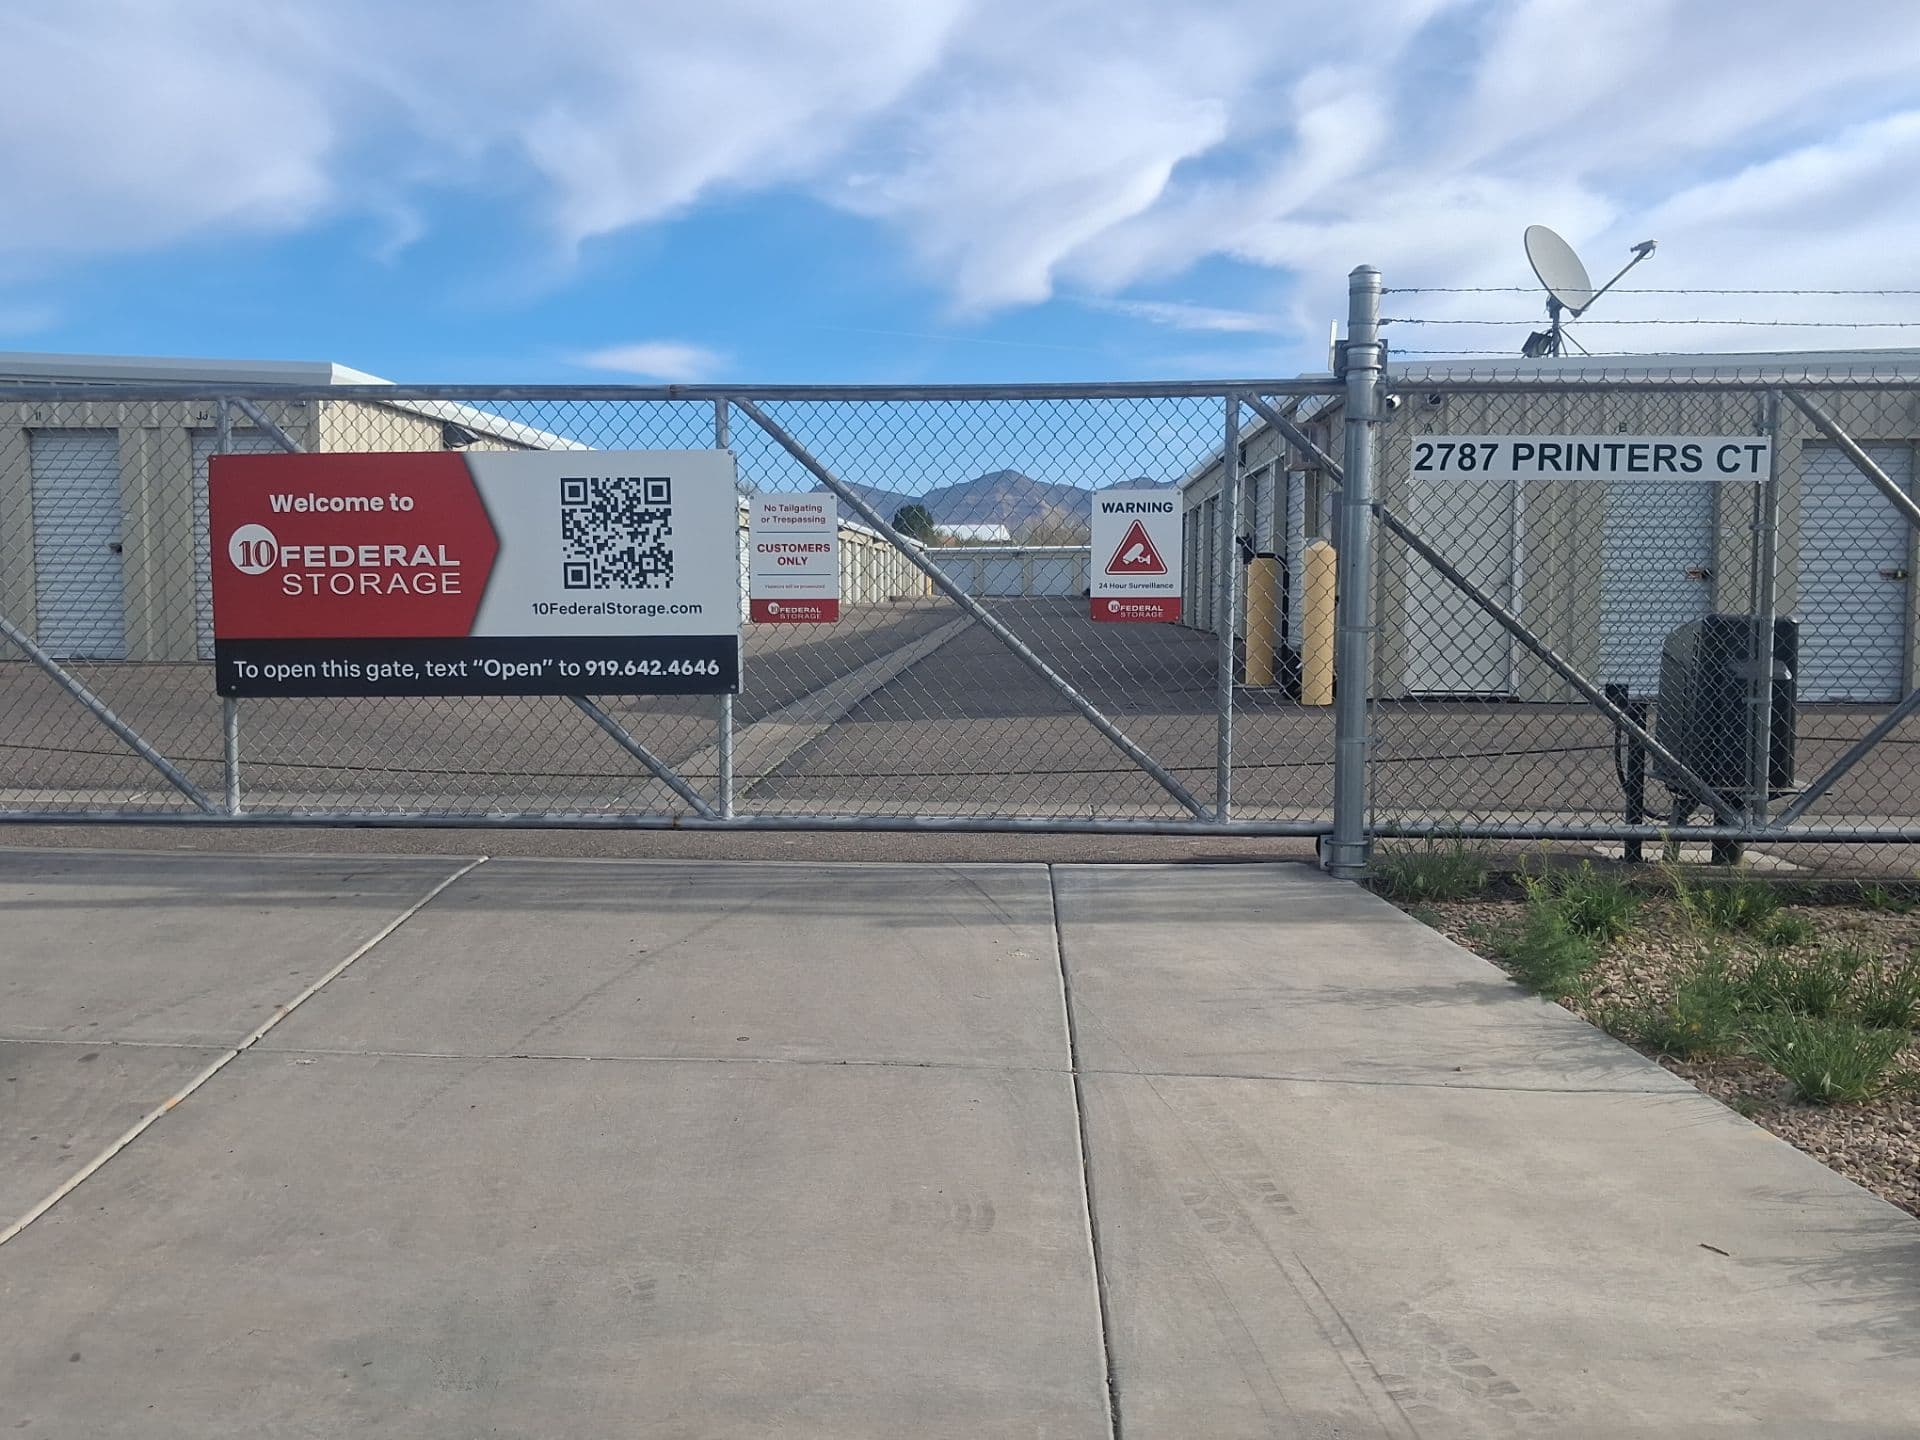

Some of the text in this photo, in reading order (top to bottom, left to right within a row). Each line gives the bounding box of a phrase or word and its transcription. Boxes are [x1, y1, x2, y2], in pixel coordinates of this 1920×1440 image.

[1424, 423, 1434, 434] A
[1619, 422, 1628, 433] B
[1414, 443, 1767, 473] 2787 PRINTERS CT
[269, 493, 414, 513] Welcome to
[764, 504, 823, 513] No Tailgating
[1102, 502, 1174, 514] WARNING
[772, 515, 826, 525] Trespassing
[238, 540, 461, 568] 10 FEDERAL
[757, 543, 831, 553] CUSTOMERS
[777, 556, 808, 566] ONLY
[282, 572, 462, 596] STORAGE
[531, 602, 703, 617] 10FederalStorage.com
[233, 659, 720, 682] To open this gate, text “Open” to 919.642.4646
